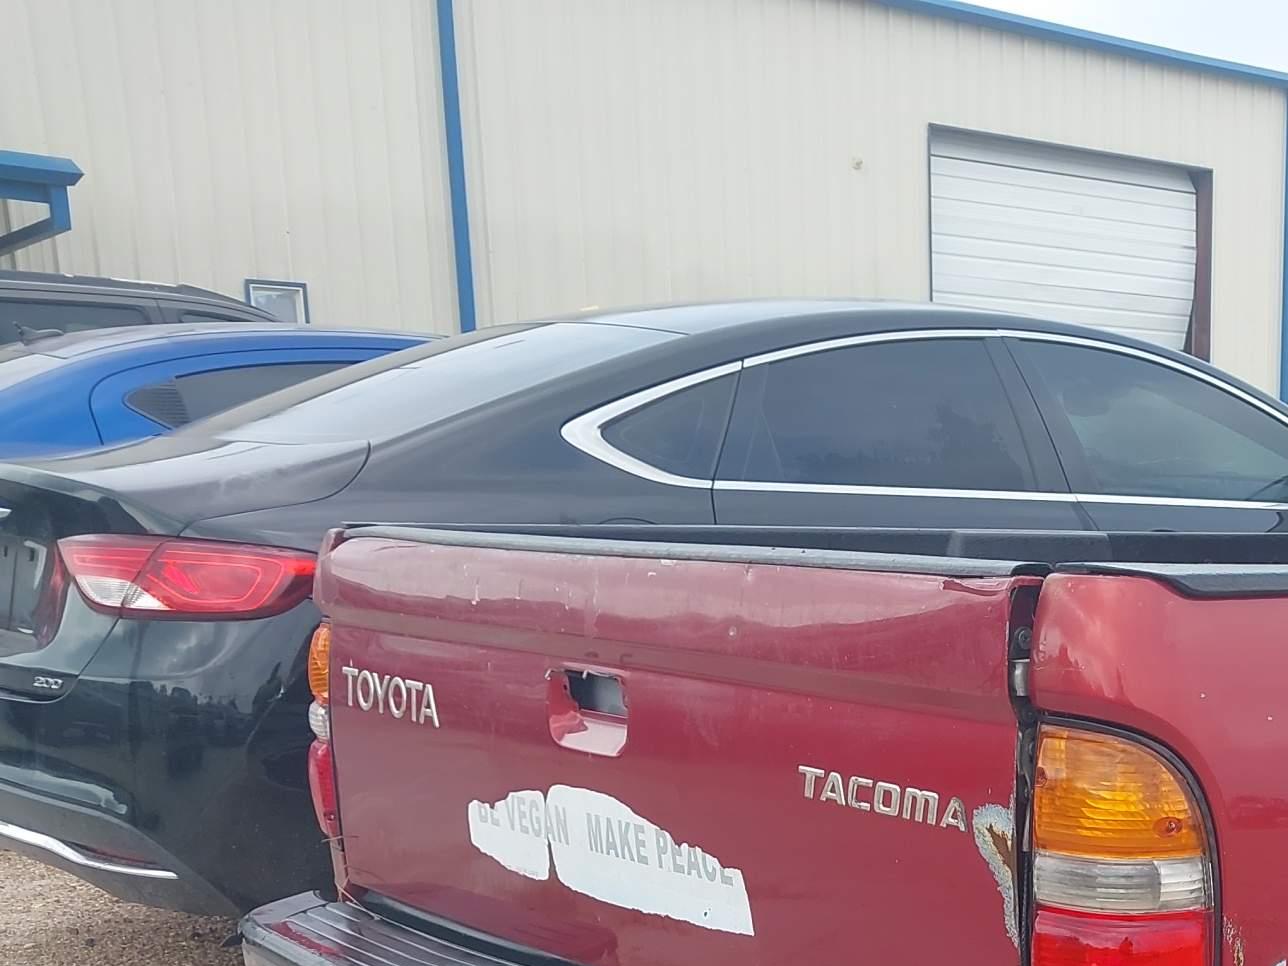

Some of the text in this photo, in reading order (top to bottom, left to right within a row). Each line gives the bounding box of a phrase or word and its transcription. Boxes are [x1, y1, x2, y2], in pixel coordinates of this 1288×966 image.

[341, 663, 440, 728] TOYOTA
[505, 795, 571, 846] VEGAN
[585, 811, 649, 866] MAKE
[798, 764, 967, 832] TACOMA
